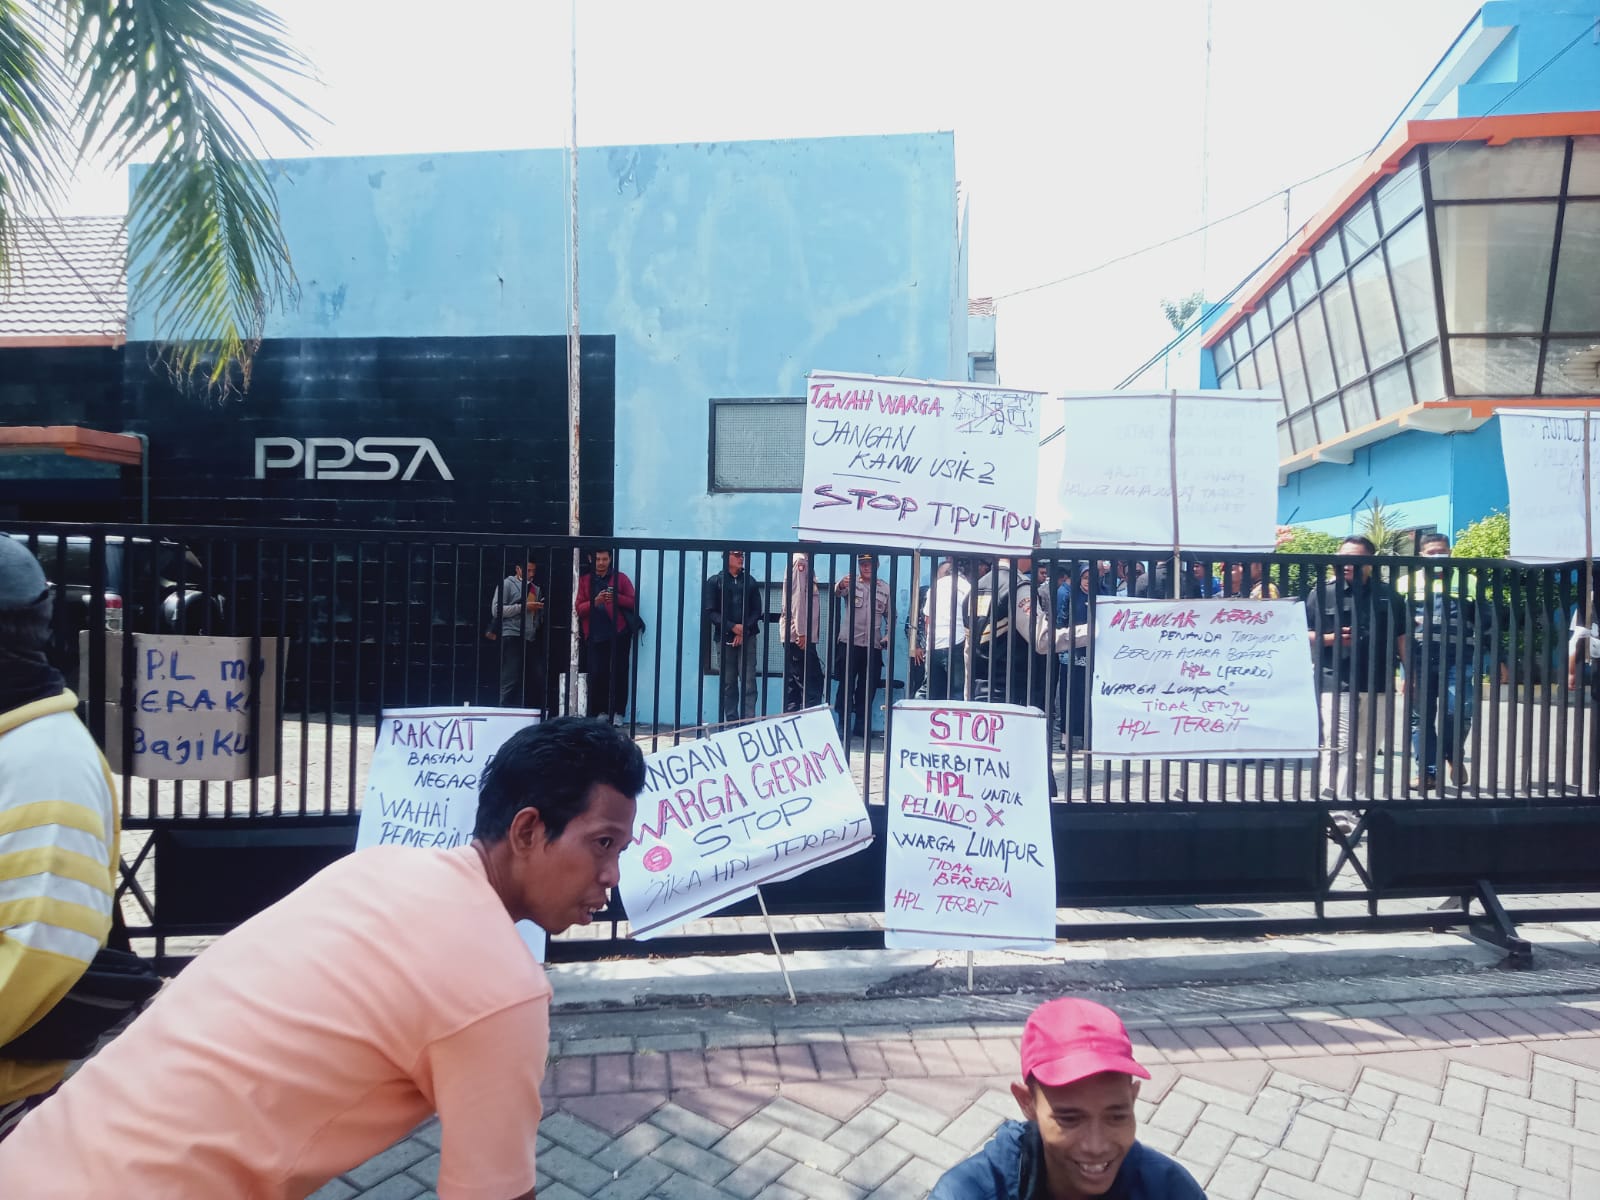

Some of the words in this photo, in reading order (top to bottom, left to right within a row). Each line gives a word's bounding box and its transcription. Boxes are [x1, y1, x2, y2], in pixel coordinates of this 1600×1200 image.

[810, 383, 874, 411] TANAH
[877, 391, 944, 417] WARGA
[812, 419, 916, 452] JANGAN
[254, 436, 455, 481] PPSA
[848, 451, 922, 474] KAMU
[812, 483, 919, 521] STOP
[1109, 608, 1200, 632] MENOLAK
[1210, 607, 1274, 625] KERAS
[1158, 630, 1222, 643] PENANDA
[1113, 645, 1173, 662] BERITA
[1176, 647, 1220, 659] ACARA
[1180, 660, 1211, 680] HPL
[1199, 700, 1250, 716] SETUJU
[391, 718, 488, 751] RAKYAT
[738, 716, 804, 763] BUAT
[929, 709, 1004, 745] STOP
[1118, 718, 1160, 741] HPL
[1170, 715, 1249, 736] TERBIT
[407, 752, 474, 766] BAGIAN
[900, 749, 1011, 779] PENERBITAN
[631, 773, 748, 846] WARGA
[751, 742, 845, 800] GERAM
[926, 771, 974, 799] HPL
[981, 788, 1023, 807] UNTUK
[901, 794, 977, 823] PELINDO
[692, 796, 813, 858] STOP
[892, 831, 956, 850] WARGA
[965, 831, 1044, 874] LUMPUR
[927, 856, 973, 875] TIDAK
[933, 872, 1012, 898] BERSEDIA
[893, 888, 925, 911] HPL
[935, 895, 999, 917] TERBIT
